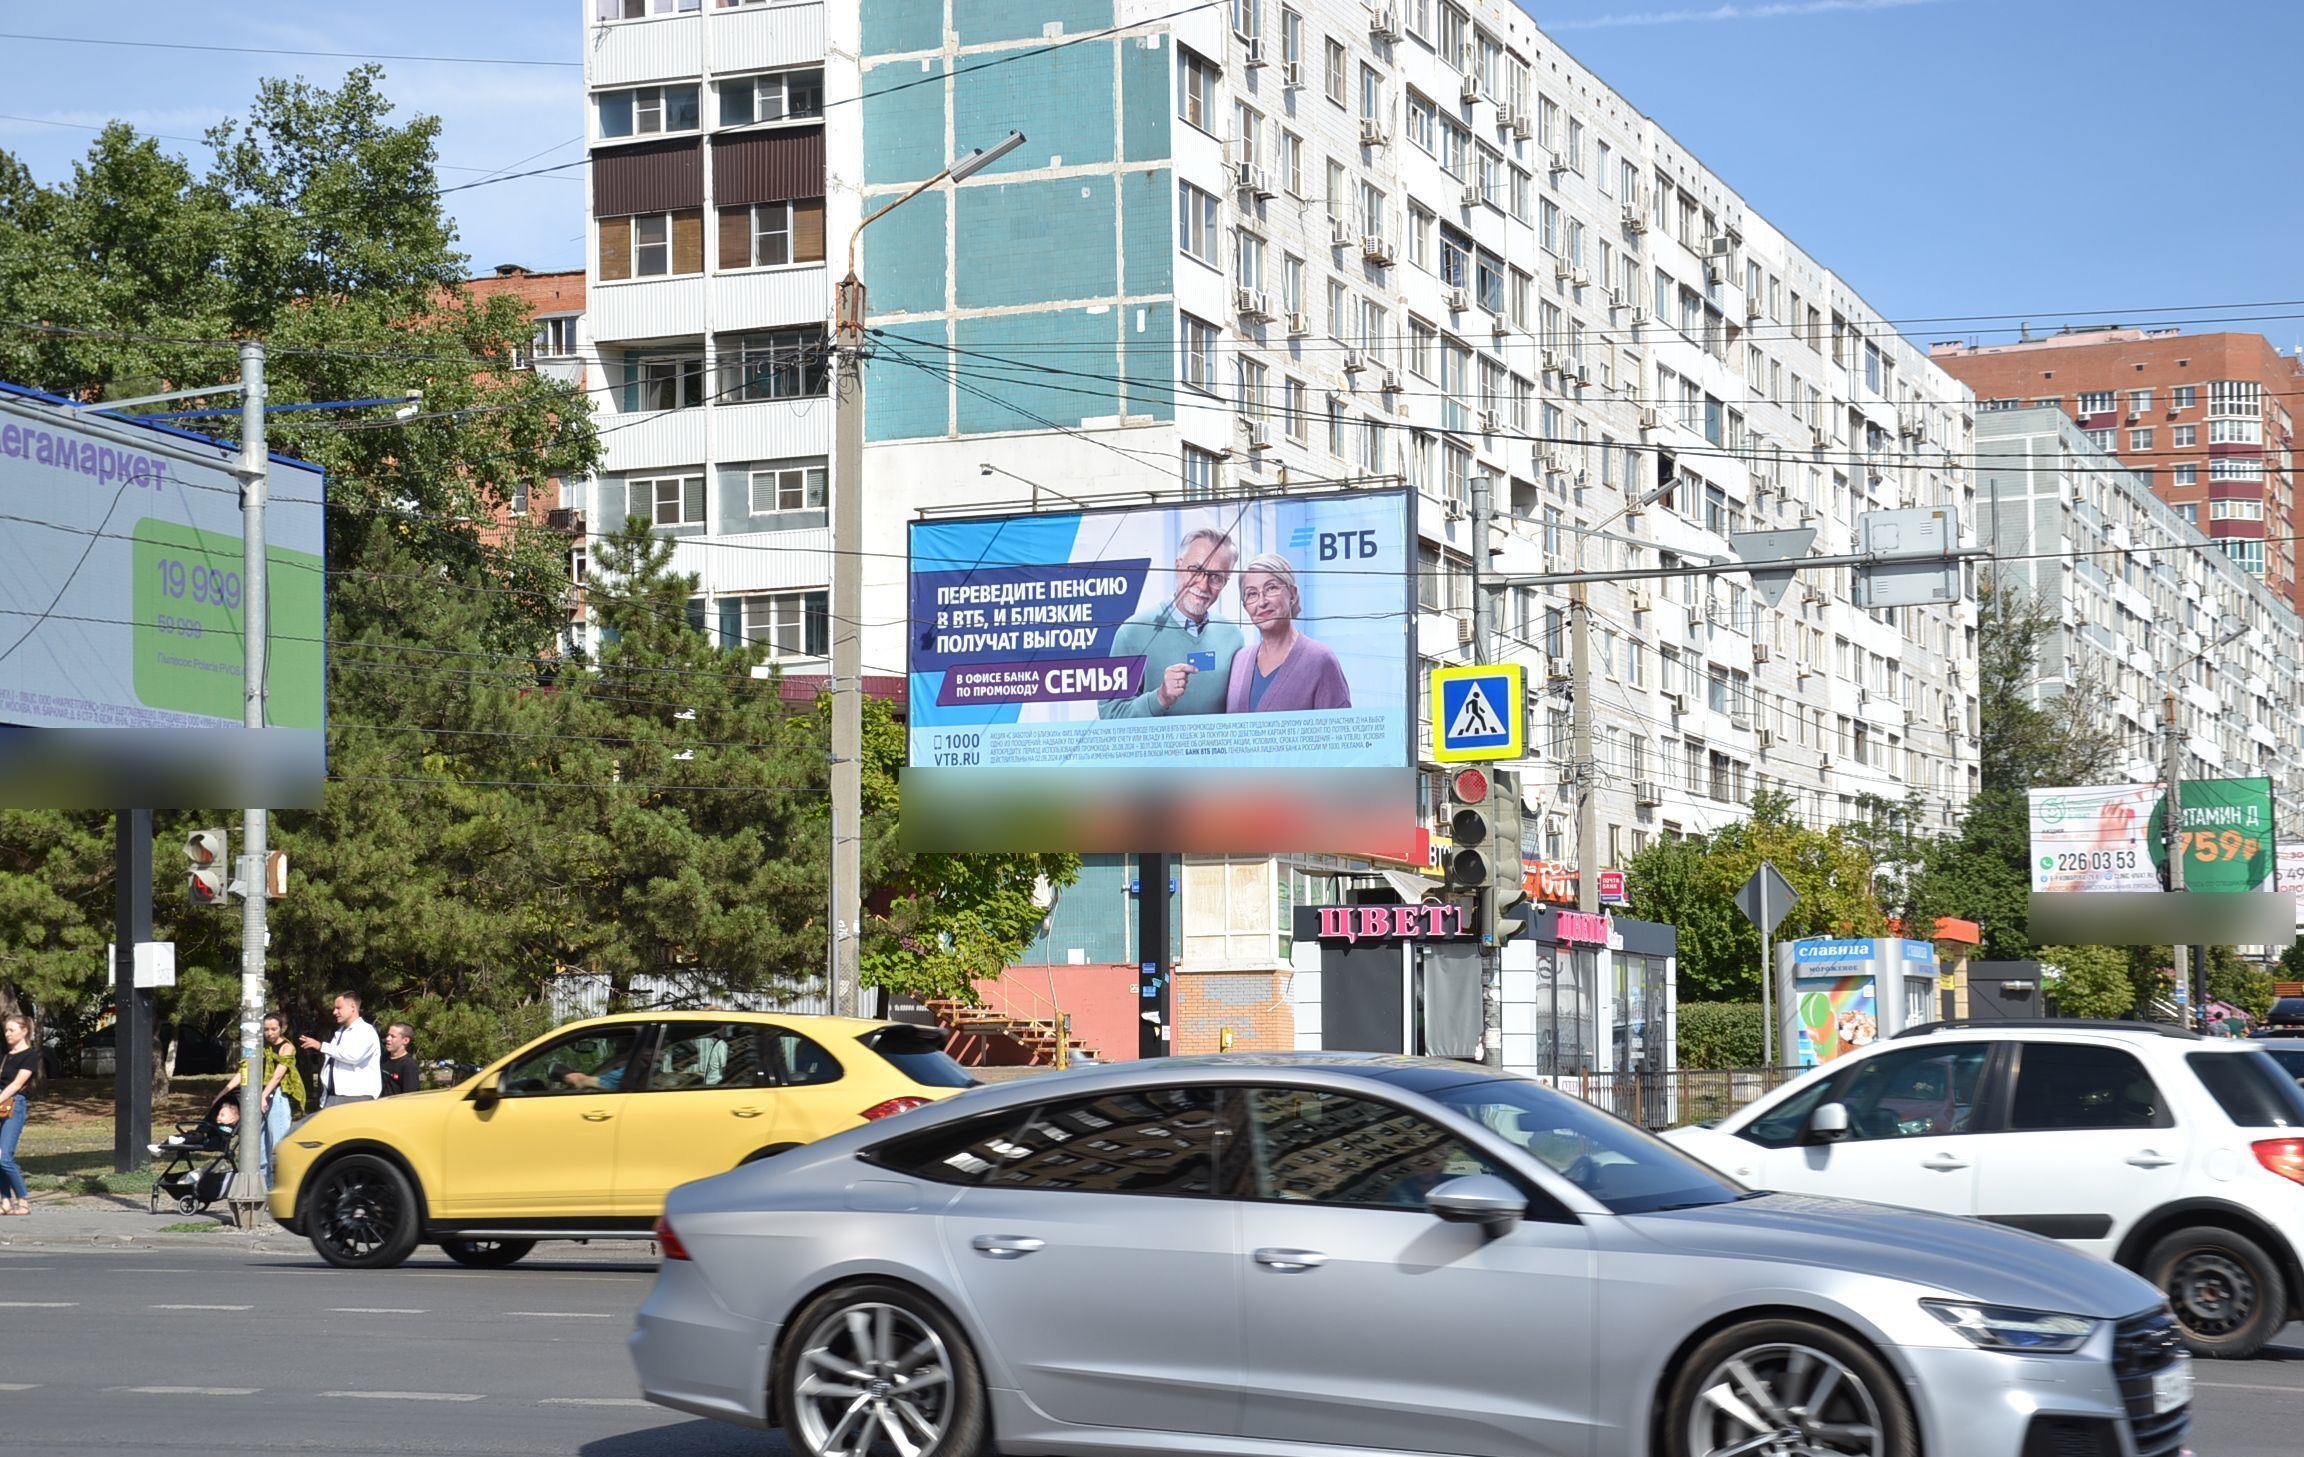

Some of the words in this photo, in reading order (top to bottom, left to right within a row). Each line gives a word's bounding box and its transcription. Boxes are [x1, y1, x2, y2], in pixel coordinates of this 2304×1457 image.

[0, 423, 166, 491] егамаркет
[1318, 528, 1378, 561] ВТБ
[157, 558, 186, 599] 19
[191, 565, 241, 609] 999
[936, 578, 1046, 606] ПЕРЕВЕДИТЕ
[1049, 575, 1128, 600] ПЕНСИЮ
[936, 611, 948, 630] В
[993, 608, 1005, 626] И
[1010, 602, 1093, 624] БЛИЗКИЕ
[936, 631, 1019, 654] ПОЛУЧАТ
[1023, 627, 1098, 652] ВЫГОДУ
[955, 687, 970, 698] ПО
[972, 683, 1039, 698] ПРОМОКОДУ
[956, 674, 963, 685] В
[966, 672, 1001, 684] ОФИСЕ
[1003, 670, 1040, 683] БАНКА
[1044, 665, 1129, 694] СЕМЬЯ
[945, 733, 980, 749] 1000
[934, 752, 980, 766] VTB.RU
[2058, 853, 2087, 871] 226
[2092, 852, 2112, 870] 03
[2116, 851, 2136, 869] 53
[1799, 944, 1869, 957] славица
